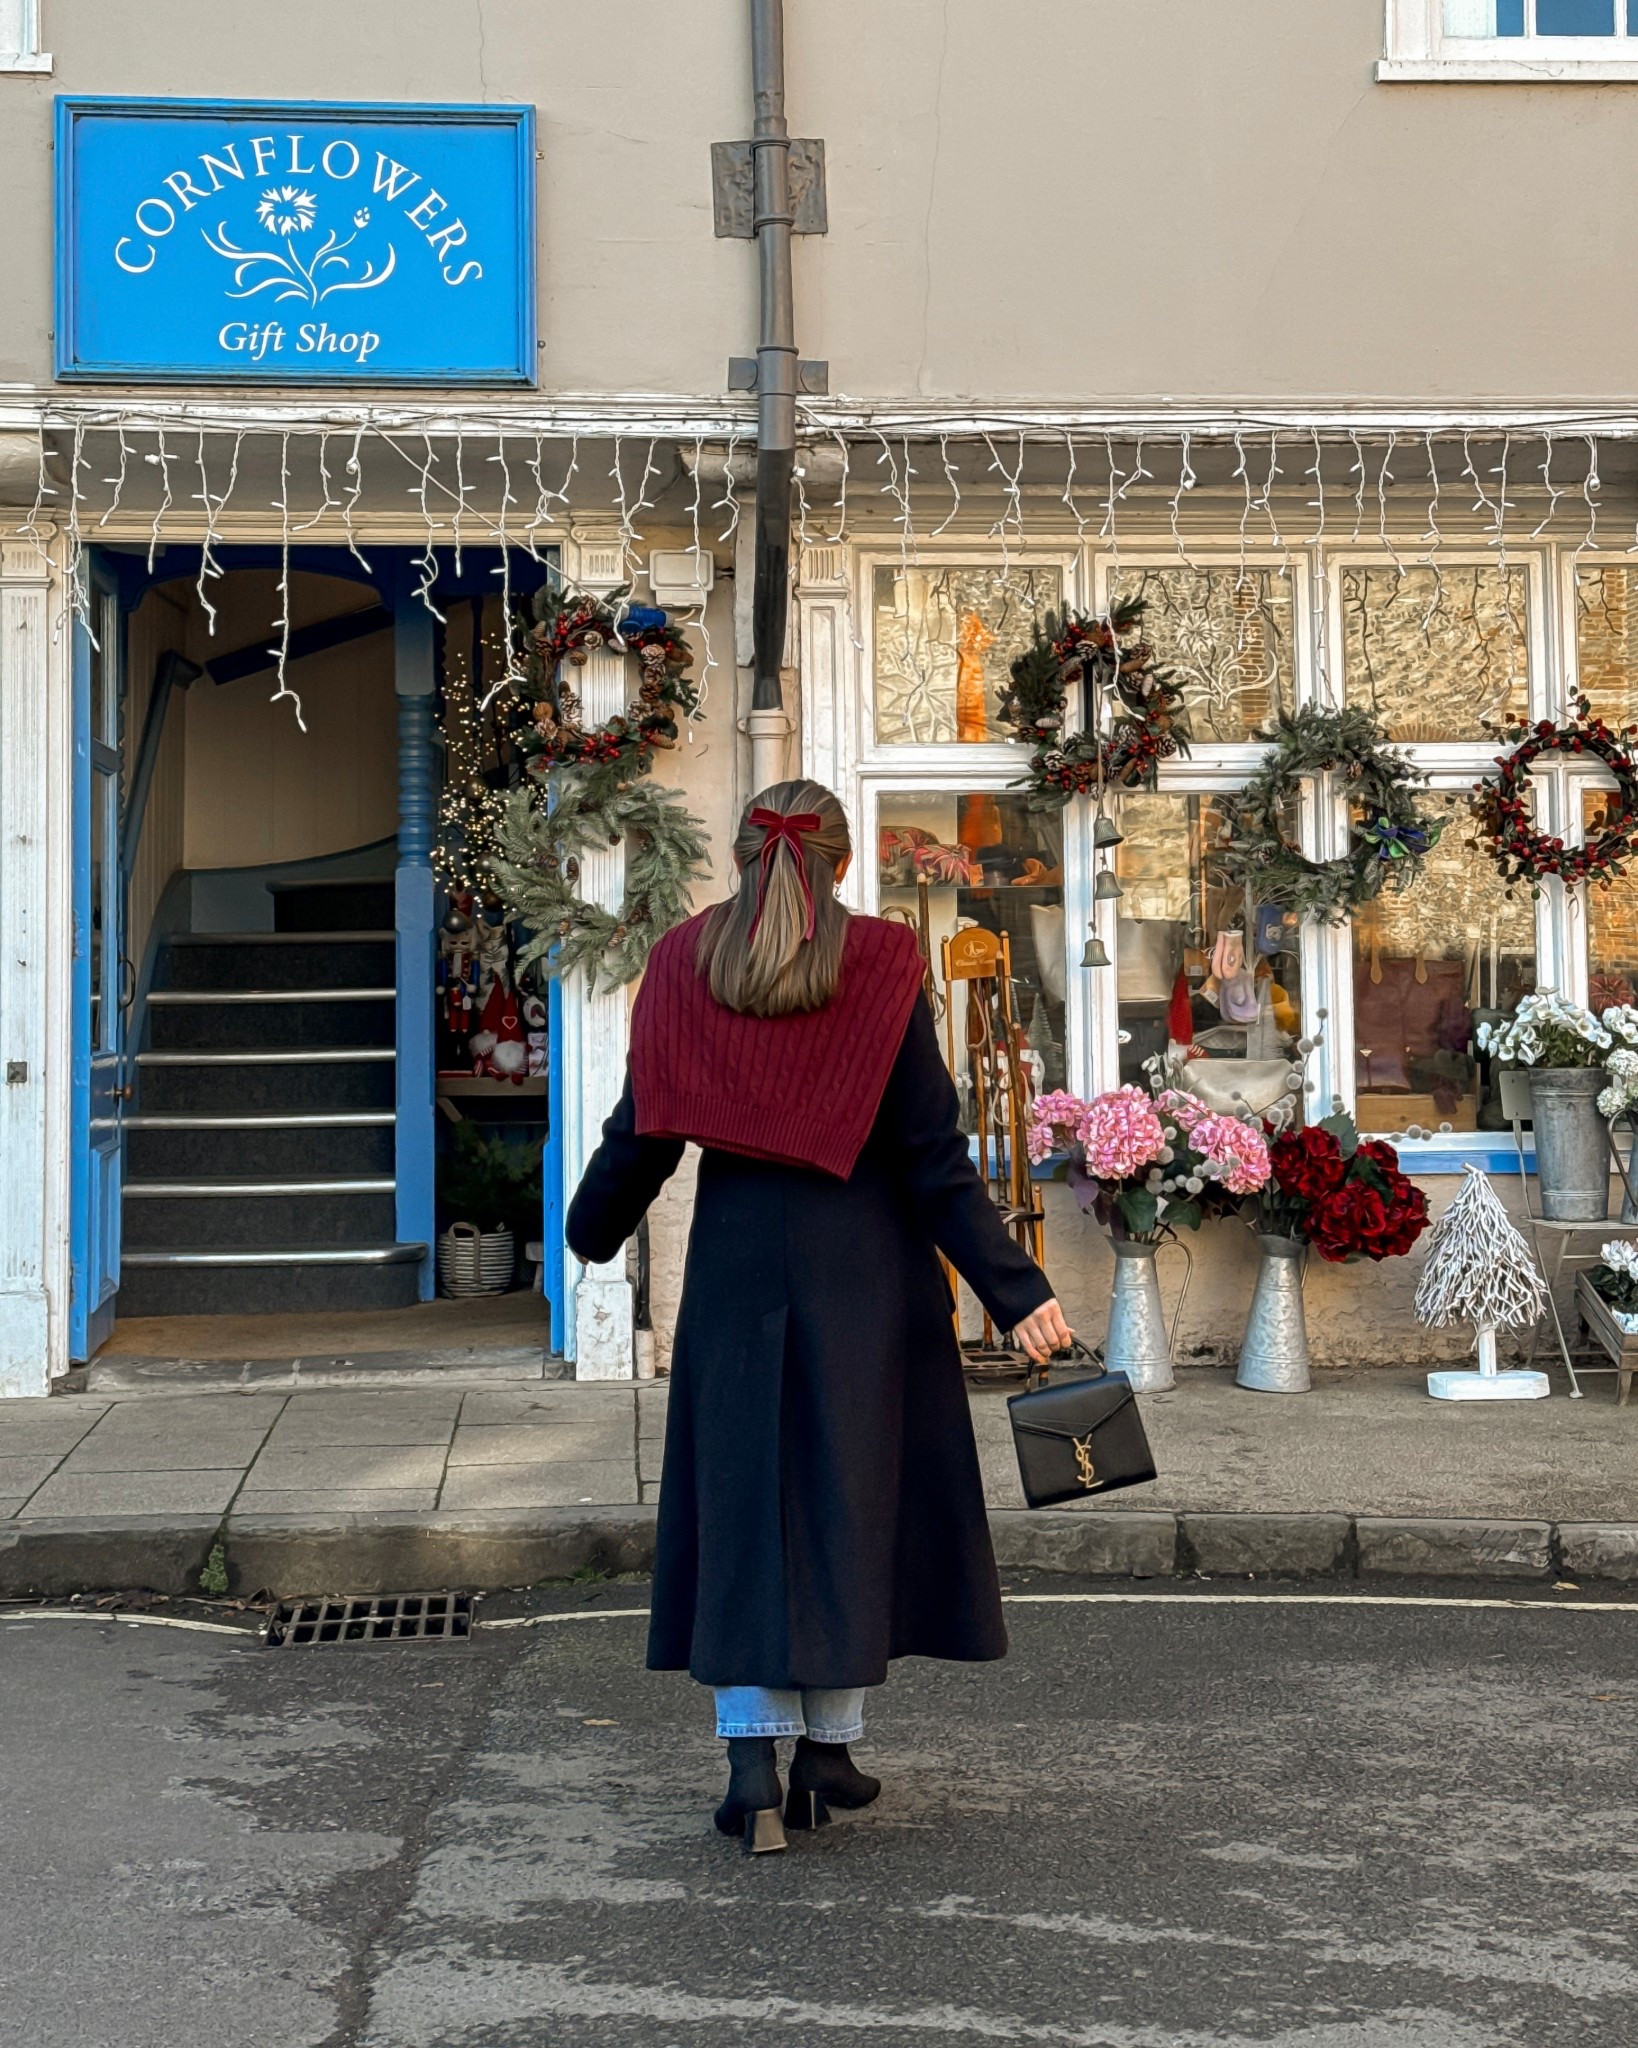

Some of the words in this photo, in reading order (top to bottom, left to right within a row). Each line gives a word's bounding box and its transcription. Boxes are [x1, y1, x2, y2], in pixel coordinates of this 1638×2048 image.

[114, 135, 483, 287] CORNFLOWERS
[218, 321, 287, 361] Gift
[295, 322, 380, 363] Shop
